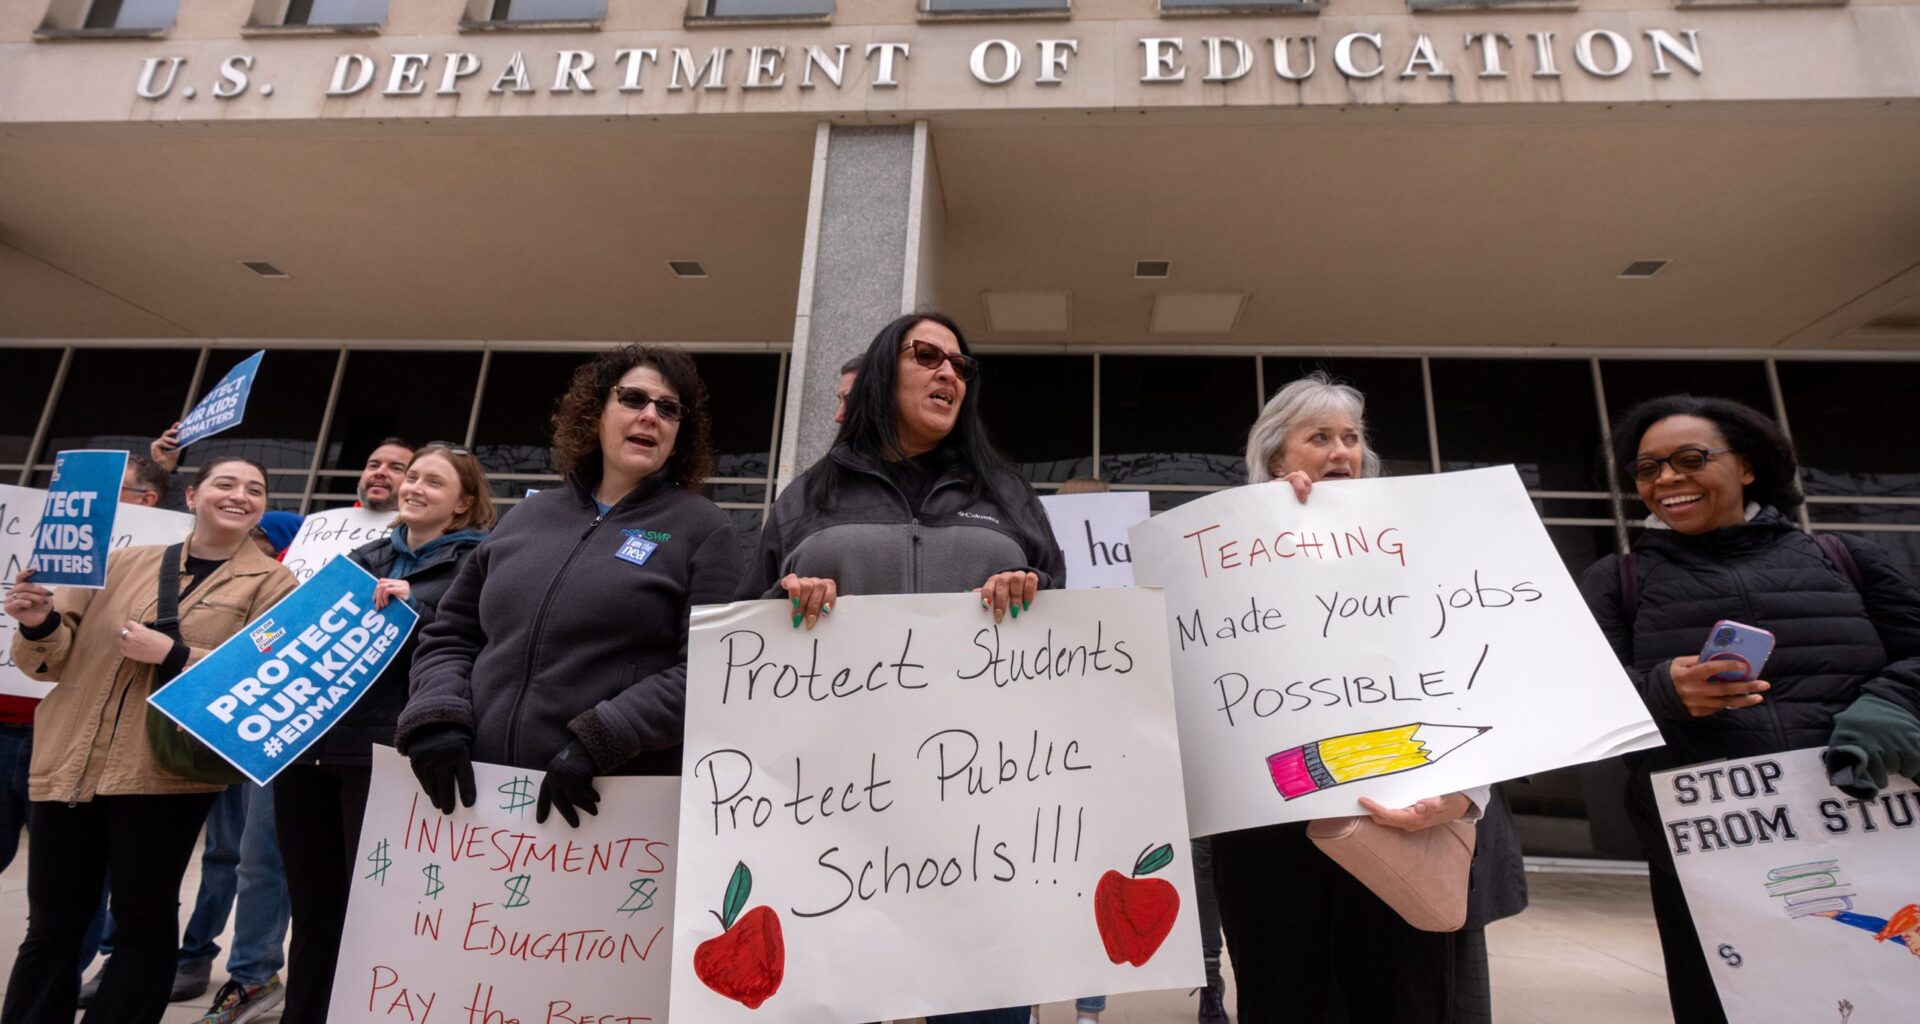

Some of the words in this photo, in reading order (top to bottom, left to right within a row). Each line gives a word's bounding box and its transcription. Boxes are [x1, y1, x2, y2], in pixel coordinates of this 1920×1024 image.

[136, 53, 273, 101] U.S.
[324, 42, 911, 96] DEPARTMENT
[968, 36, 1078, 85] OF
[1139, 28, 1706, 84] EDUCATION
[206, 393, 240, 418] KIDS
[39, 523, 94, 551] KIDS
[965, 512, 1000, 524] Columbia
[1183, 524, 1407, 578] TEACHING
[621, 546, 646, 561] nea
[251, 620, 273, 638] COLOR
[255, 635, 264, 644] OF
[259, 629, 285, 650] CHANGE
[1176, 597, 1287, 652] Made
[1315, 589, 1411, 638] your
[1429, 569, 1543, 639] jobs
[206, 591, 361, 724] PROTECT
[237, 676, 321, 742] OUR
[310, 609, 385, 681] KIDS
[262, 623, 399, 758] #EDMATTERS
[720, 628, 929, 705] Protect
[956, 620, 1133, 688] Students
[1213, 643, 1490, 727] POSSIBLE!
[694, 748, 895, 836] Protect
[917, 728, 1092, 802] Public
[1672, 759, 1785, 806] STOP
[403, 791, 670, 874] INVESTMENTS
[1666, 804, 1799, 856] FROM
[1817, 790, 1920, 835] STU
